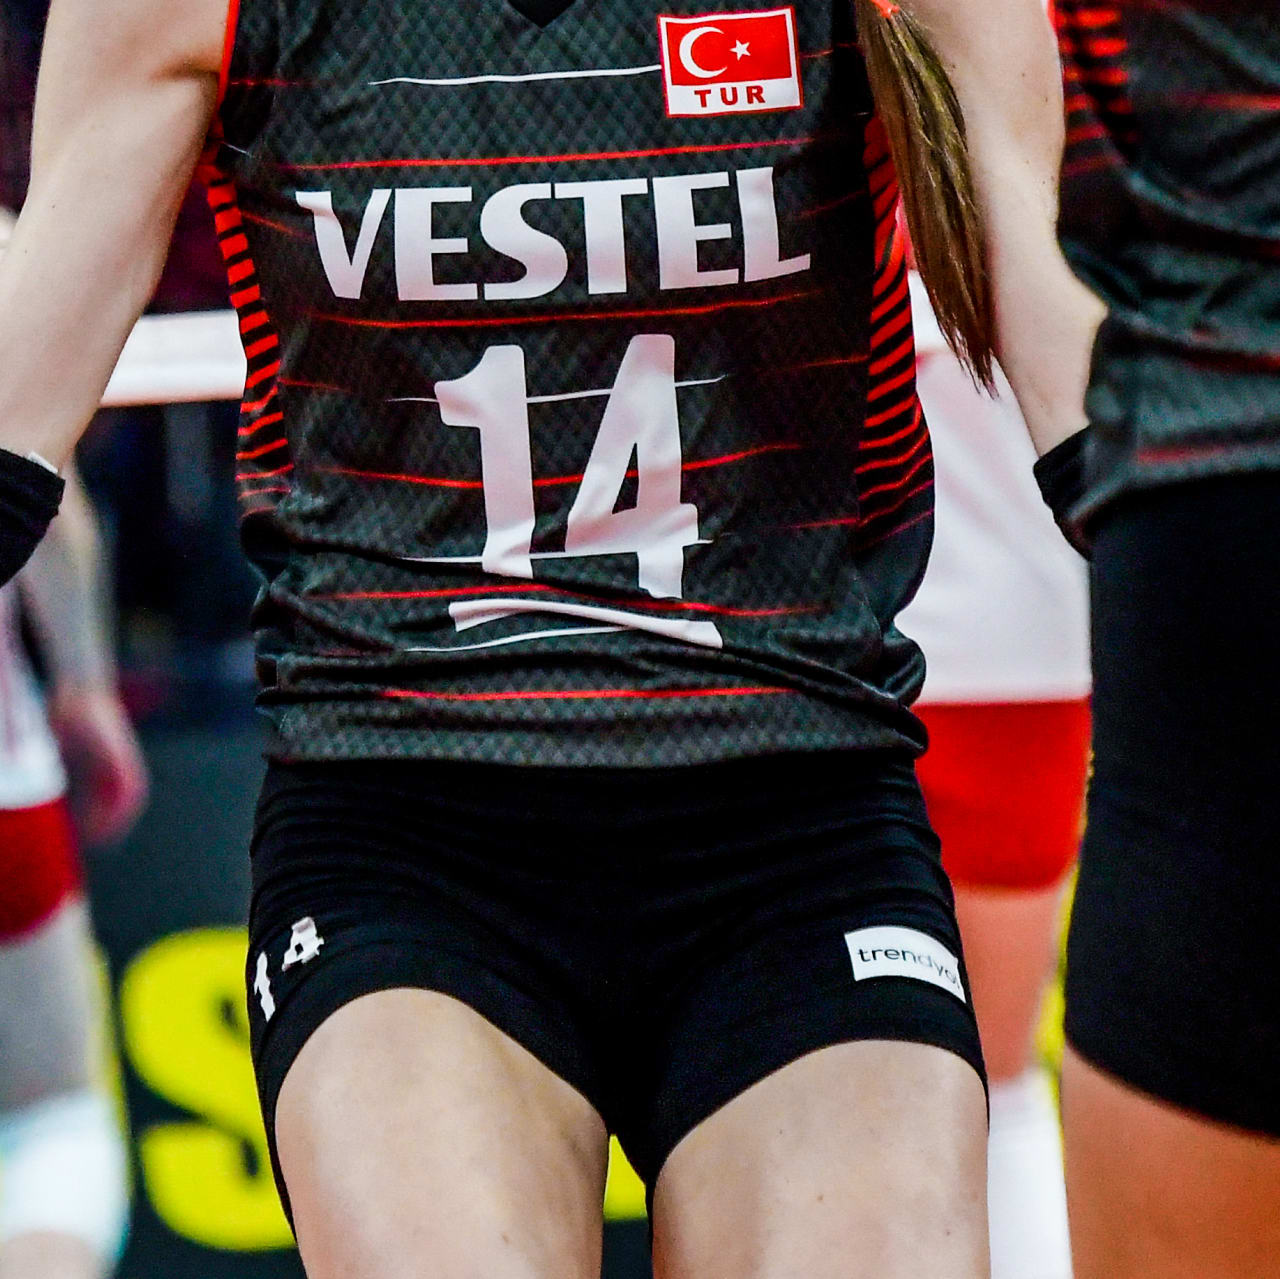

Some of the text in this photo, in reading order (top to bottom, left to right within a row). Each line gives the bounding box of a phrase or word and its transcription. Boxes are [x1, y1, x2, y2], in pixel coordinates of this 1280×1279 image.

[694, 84, 767, 108] TUR
[295, 166, 812, 302] VESTEL
[433, 333, 699, 599] 14
[253, 915, 325, 1023] 14
